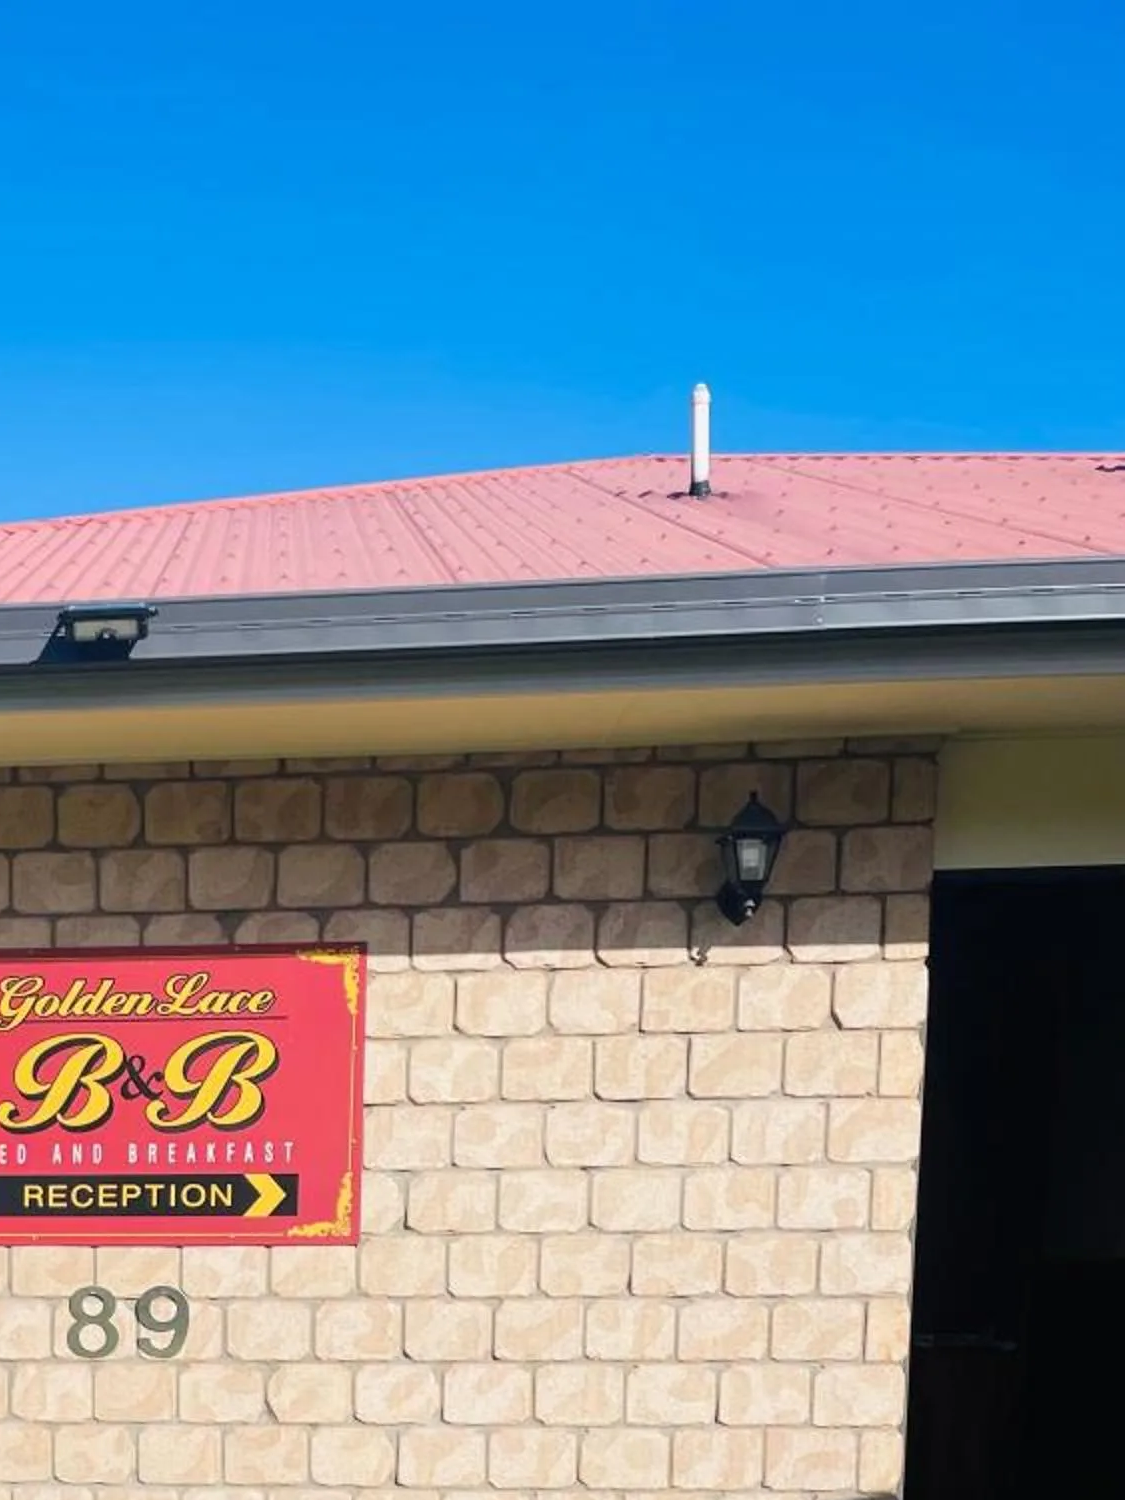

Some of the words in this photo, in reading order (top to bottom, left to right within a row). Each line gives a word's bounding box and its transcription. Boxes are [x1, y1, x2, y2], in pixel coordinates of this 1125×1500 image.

[155, 973, 278, 1016] Lace
[52, 1142, 104, 1164] AND
[127, 1140, 296, 1165] BREAKFAST
[23, 1183, 234, 1210] RECEPTION
[66, 1285, 190, 1359] 89
